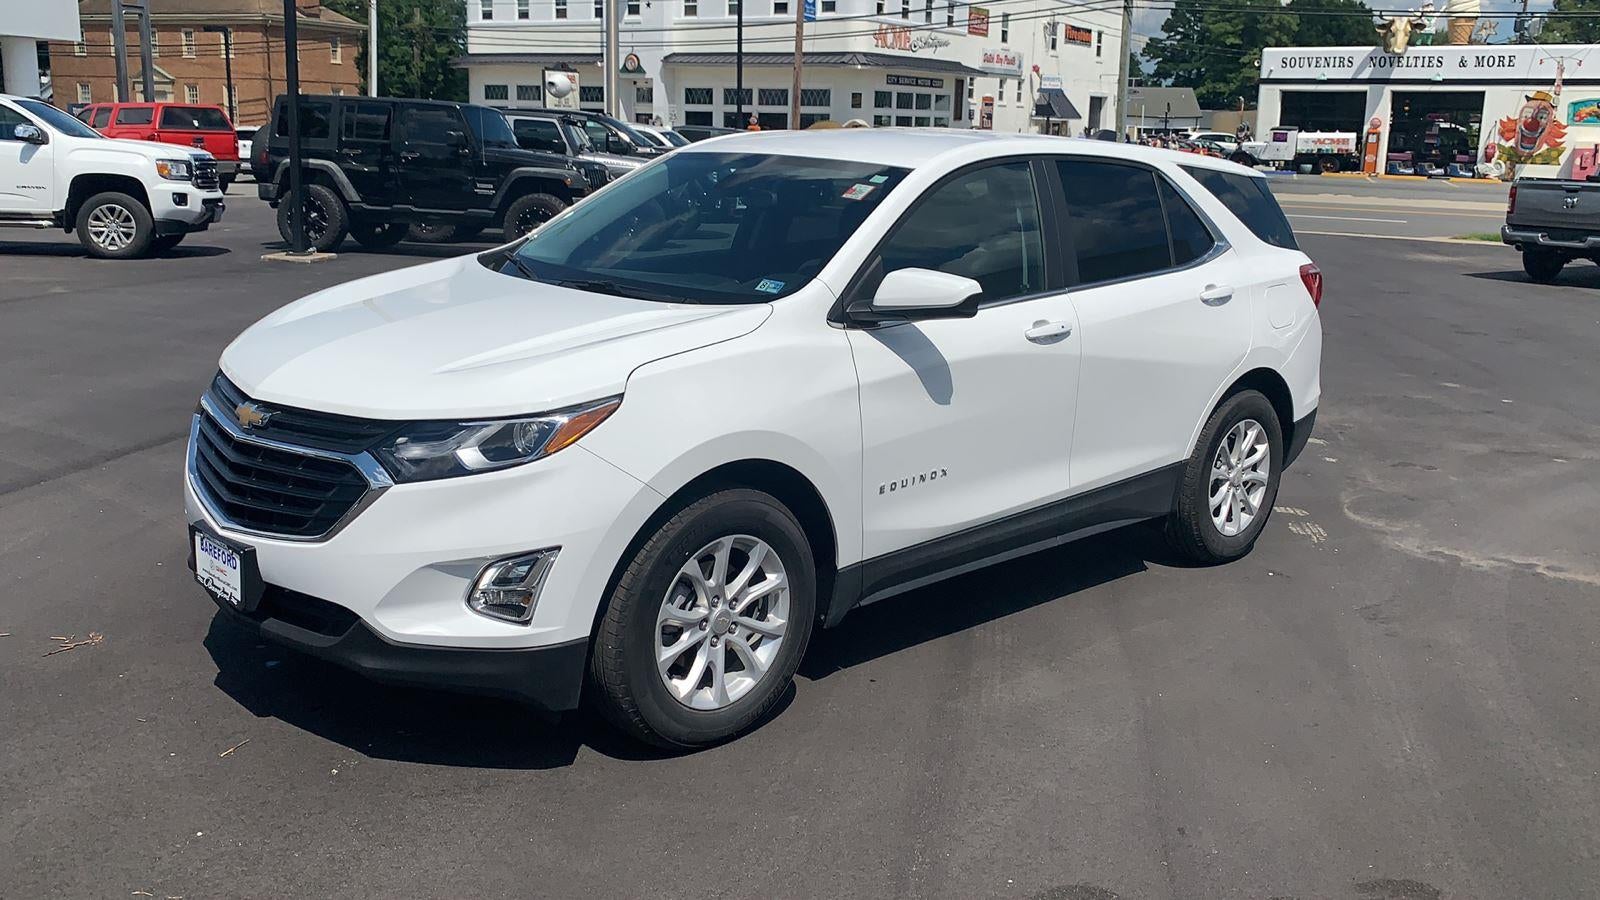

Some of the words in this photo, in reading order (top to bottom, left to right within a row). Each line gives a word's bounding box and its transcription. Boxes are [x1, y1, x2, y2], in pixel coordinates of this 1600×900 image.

[873, 24, 912, 51] ACME
[1281, 56, 1354, 69] SOUVENIRS
[1369, 55, 1444, 68] NOVELTIES
[1458, 56, 1468, 68] &
[1475, 55, 1516, 68] MORE
[898, 76, 916, 85] SERVICE
[917, 78, 931, 86] MOTOR
[879, 468, 948, 495] EQUINOX
[200, 539, 237, 570] BAREFORD
